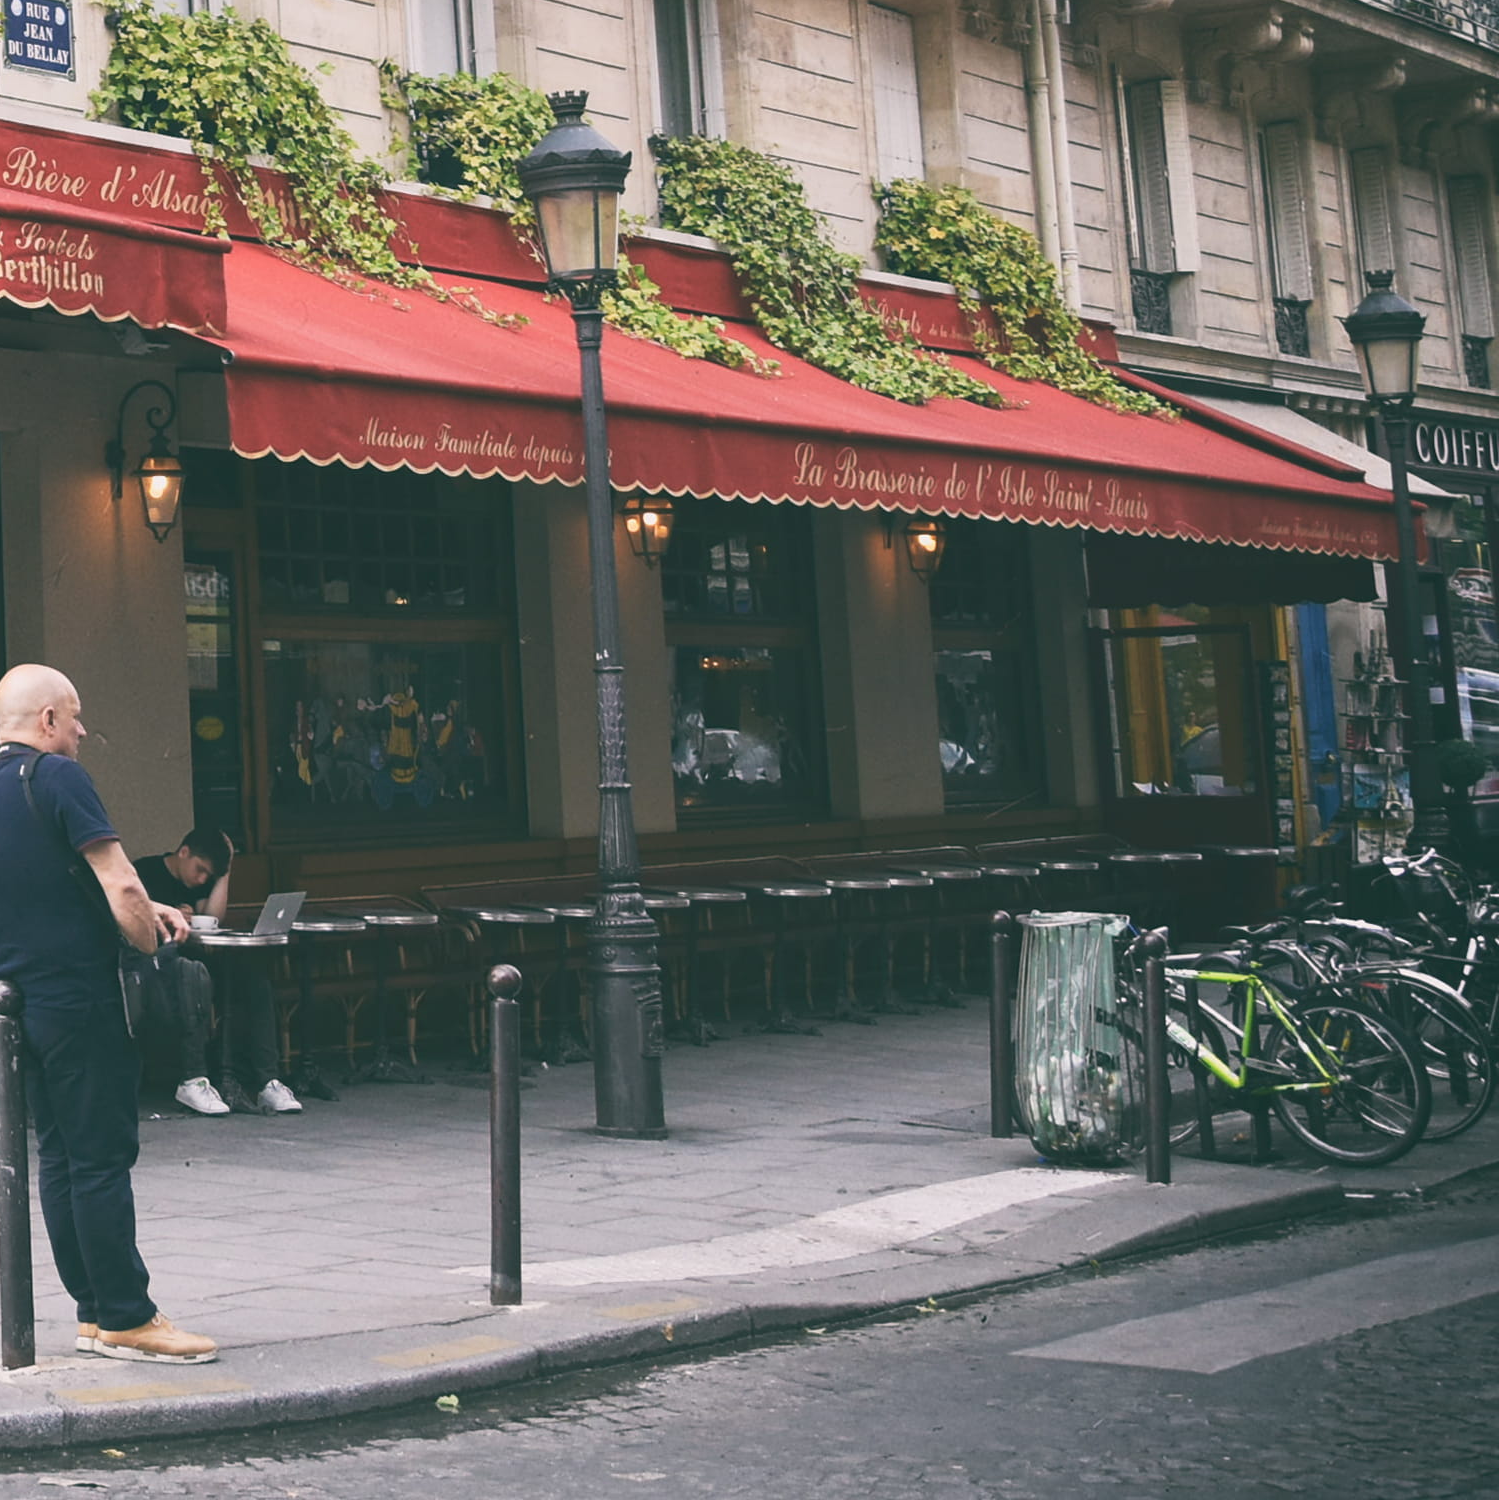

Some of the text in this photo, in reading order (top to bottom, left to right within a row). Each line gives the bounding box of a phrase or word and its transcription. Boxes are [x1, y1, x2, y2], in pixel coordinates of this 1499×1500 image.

[25, 2, 50, 21] RUE
[23, 23, 53, 42] JEAN
[8, 40, 70, 66] DU BELLAY
[1, 146, 92, 197] Bière
[14, 221, 99, 261] Sorbets
[358, 416, 429, 450] Maison
[433, 422, 519, 460] Familiale
[522, 434, 575, 473] depuis
[792, 442, 828, 488] La
[832, 446, 938, 497] Brasserie
[943, 462, 971, 501] de
